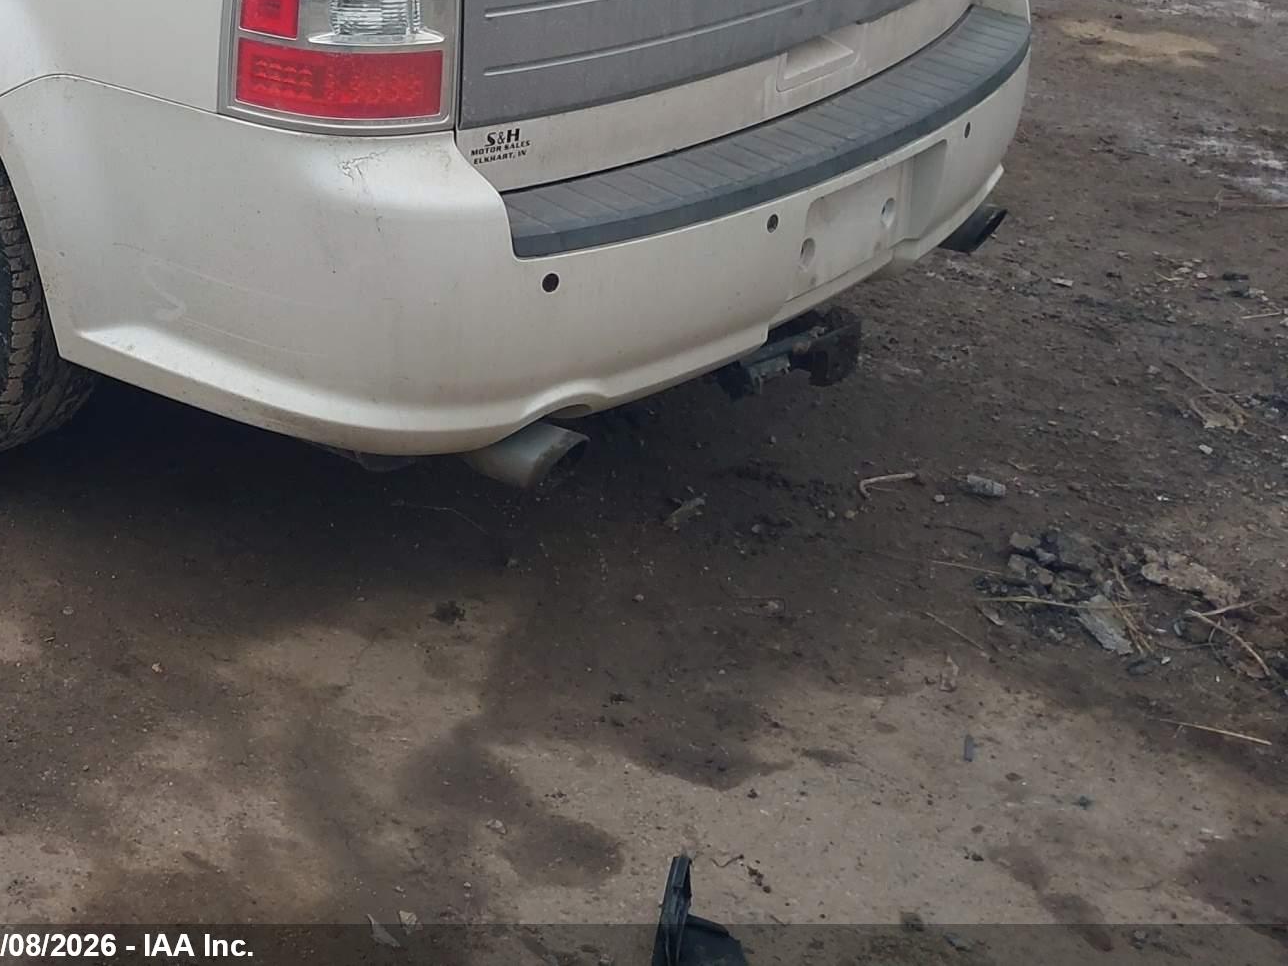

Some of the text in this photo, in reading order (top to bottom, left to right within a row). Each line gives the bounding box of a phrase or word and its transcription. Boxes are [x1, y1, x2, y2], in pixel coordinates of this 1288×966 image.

[485, 128, 520, 146] S&H
[470, 140, 530, 156] MOTOR SALES
